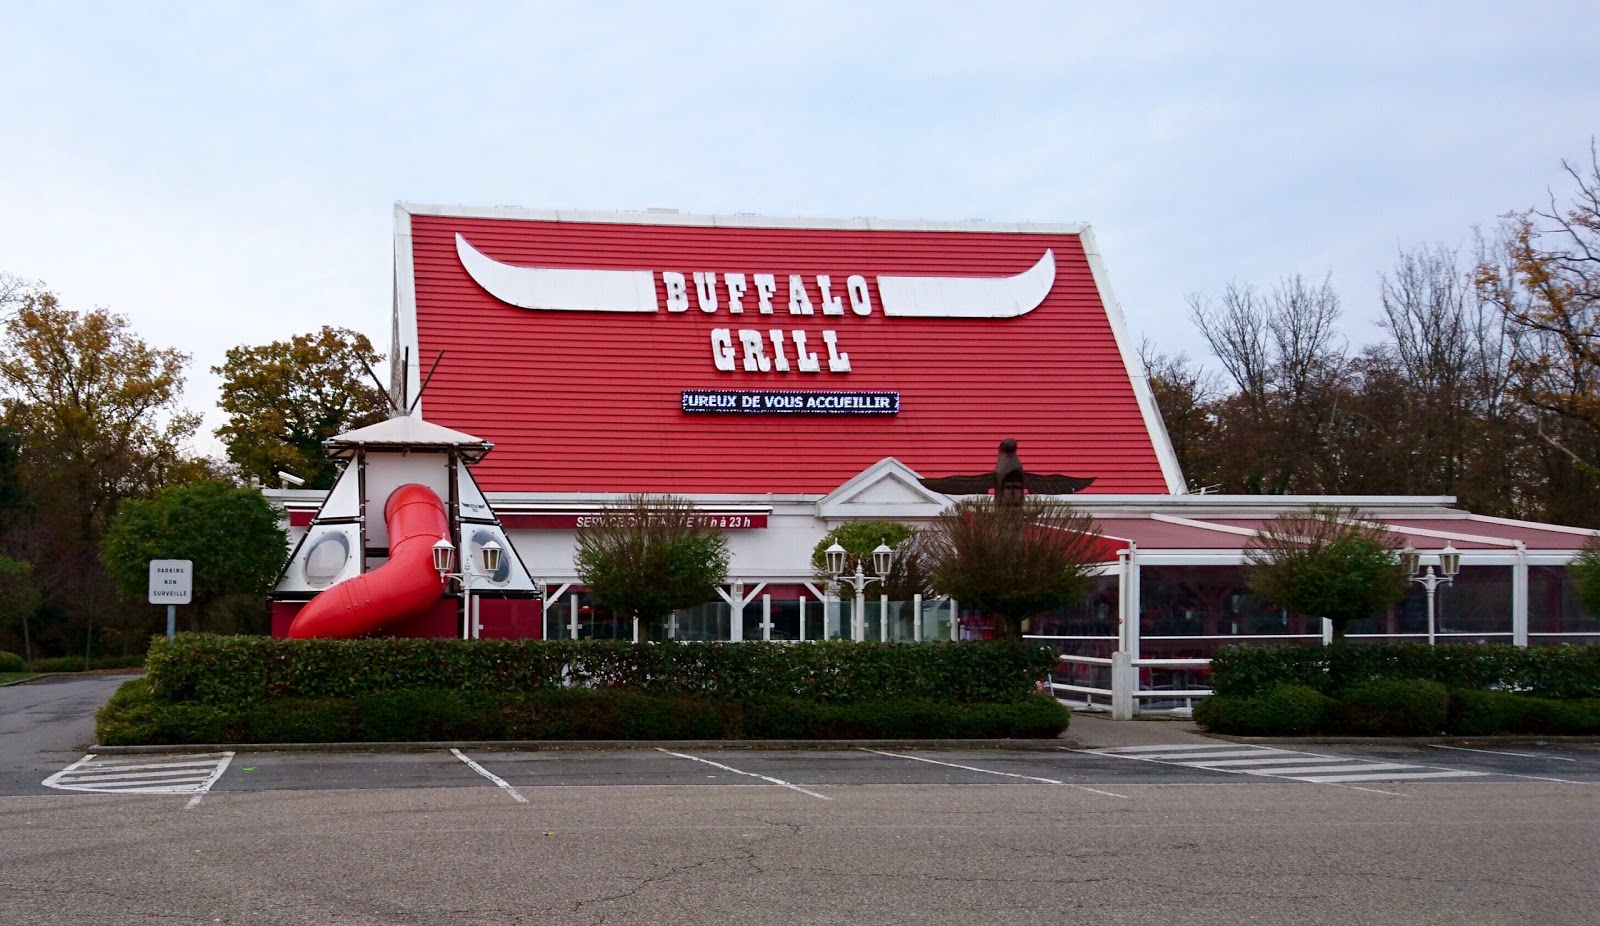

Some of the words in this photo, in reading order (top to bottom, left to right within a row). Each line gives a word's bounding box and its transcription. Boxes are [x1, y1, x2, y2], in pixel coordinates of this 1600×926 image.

[662, 271, 872, 316] BUFFALO
[711, 328, 851, 372] GRILL
[741, 396, 761, 408] DE
[764, 396, 803, 409] VOUS
[806, 396, 890, 409] ACCUEILLIR
[719, 516, 727, 528] à
[729, 516, 742, 528] 23
[743, 516, 751, 528] h
